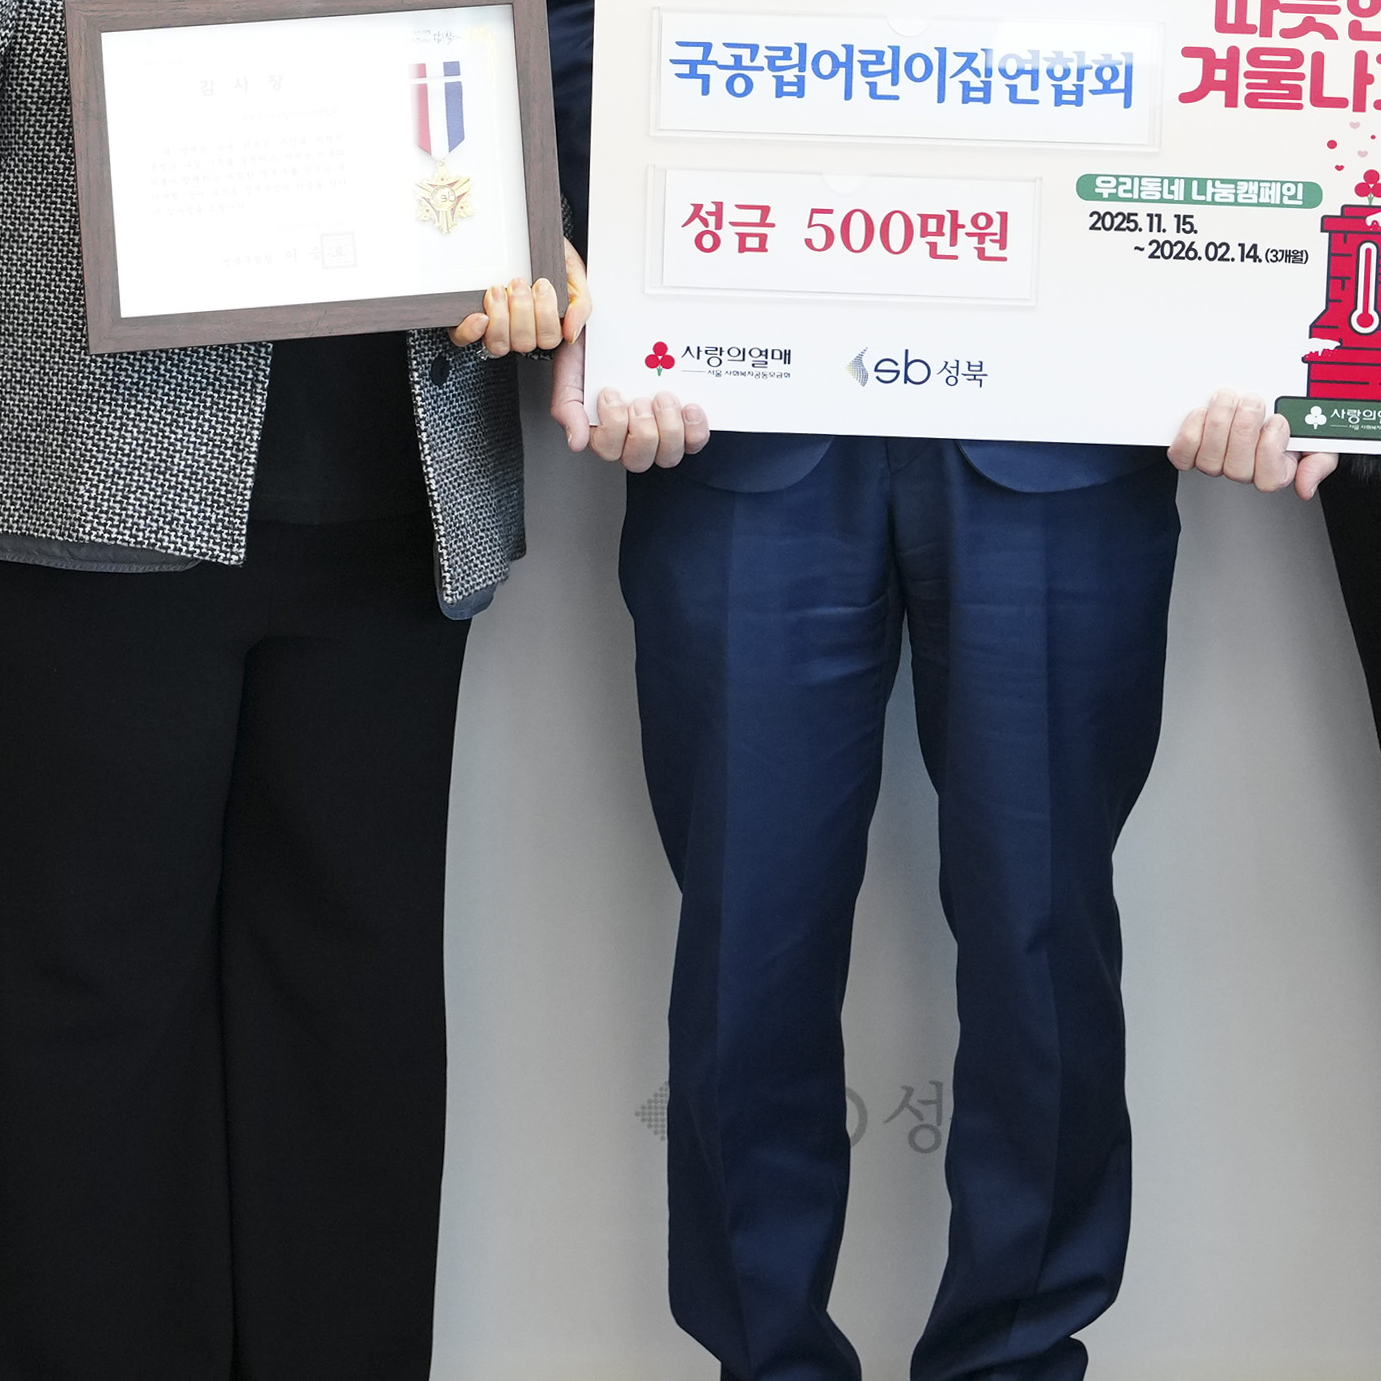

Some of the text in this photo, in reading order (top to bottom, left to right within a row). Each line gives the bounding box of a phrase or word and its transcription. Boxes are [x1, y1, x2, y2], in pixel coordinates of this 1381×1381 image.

[669, 39, 1134, 109] 국공립어린이집연합회
[1094, 175, 1304, 206] 우리동네 나눔캠페인
[681, 201, 1009, 263] 성금 500만원
[681, 345, 791, 369] 사랑의열매
[874, 349, 989, 389] sb 성북
